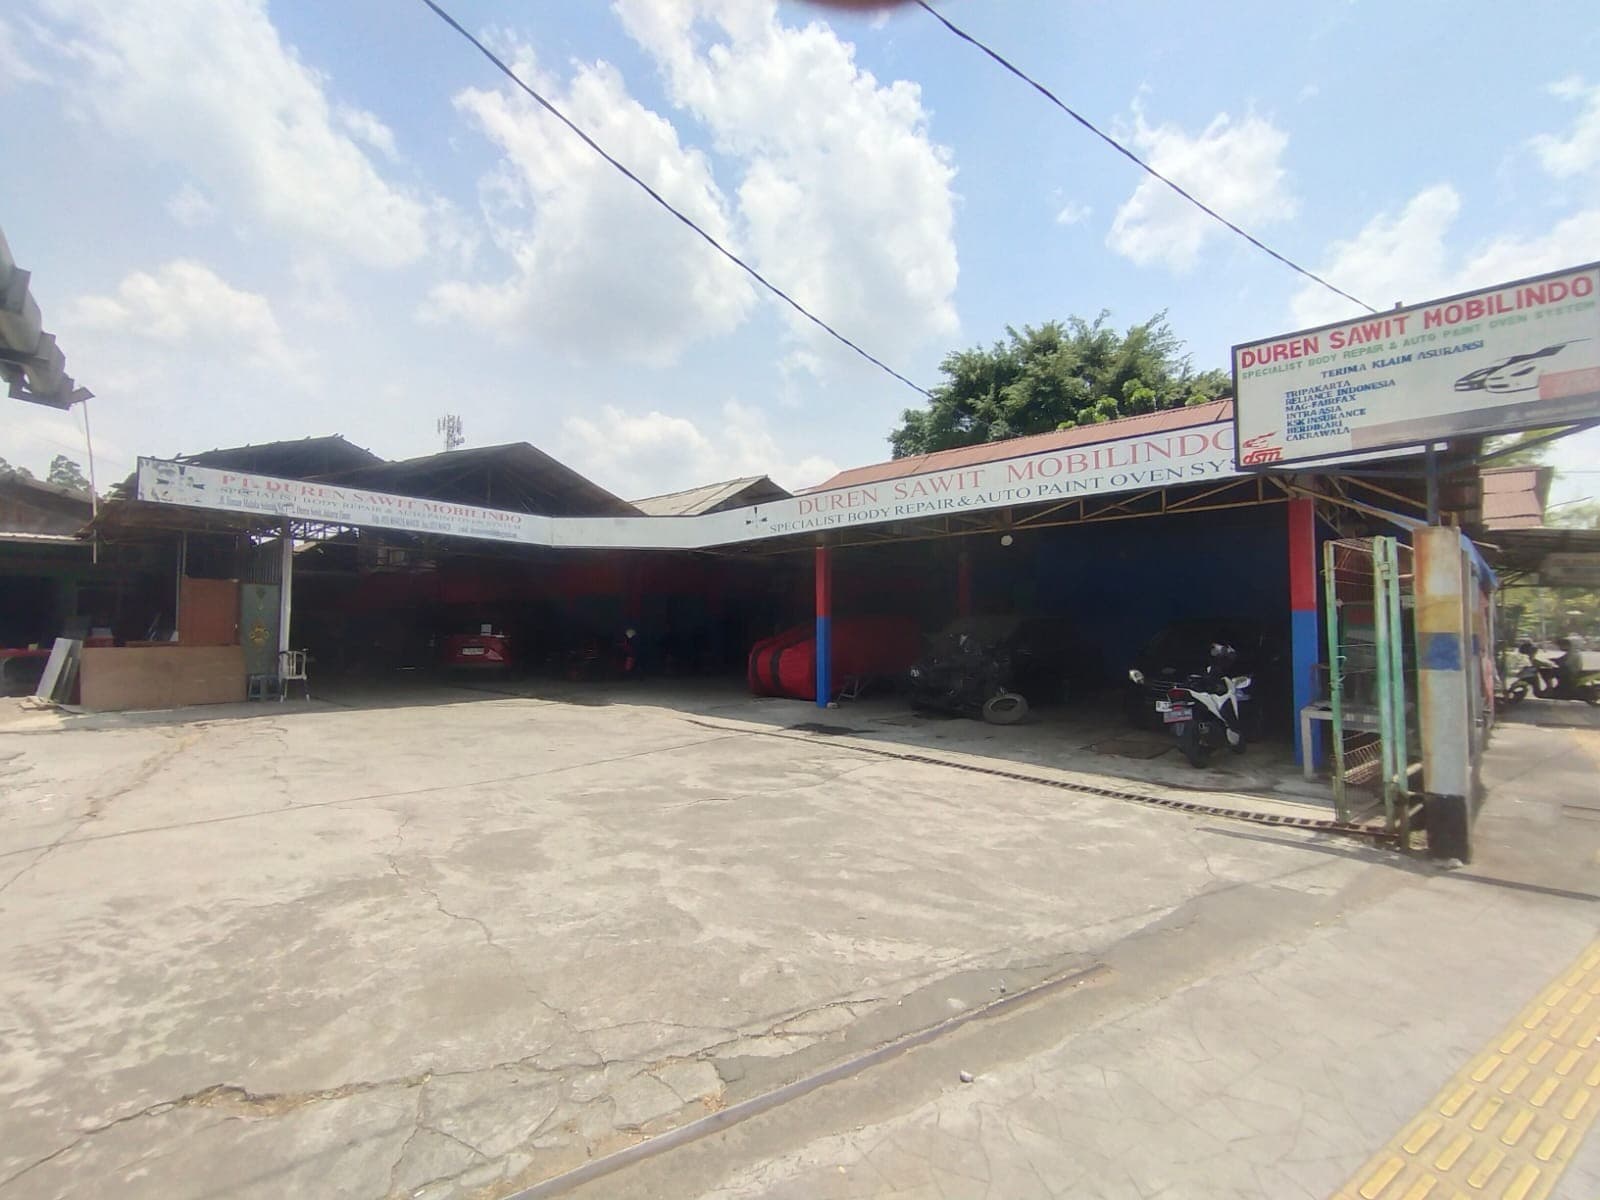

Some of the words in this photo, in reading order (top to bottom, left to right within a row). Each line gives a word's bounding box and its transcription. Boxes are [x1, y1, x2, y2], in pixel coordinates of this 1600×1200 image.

[1241, 336, 1319, 369] DUREN
[1330, 316, 1410, 350] SAWIT
[1423, 275, 1594, 330] MOBILINDO
[1242, 362, 1303, 379] SPECIALIST
[1308, 354, 1337, 367] BODY
[1343, 345, 1384, 359] REPAIR
[1389, 342, 1398, 350] &
[1403, 332, 1436, 347] AUTO
[1443, 323, 1482, 339] PAINT
[1320, 364, 1367, 380] TERIMA
[1372, 354, 1413, 369] KLAIM
[1417, 339, 1485, 361] ASURANSI
[1285, 380, 1351, 398] TRIPAKARTA
[1285, 390, 1334, 406] RELIANCE
[1337, 379, 1396, 396] INDONESIA
[1286, 426, 1351, 442] CAKRAWALA
[1306, 408, 1367, 426] INSURANCE
[265, 480, 346, 500] DUREN
[352, 493, 415, 510] SAWIT
[769, 514, 844, 534] SPECIALIST
[848, 507, 890, 523] BODY
[895, 498, 954, 516] REPAIR
[973, 487, 1031, 505] AUTO
[1037, 476, 1105, 497] PAINT
[1110, 466, 1183, 487] OVEN
[798, 489, 879, 516] DUREN
[894, 469, 985, 500] SAWIT
